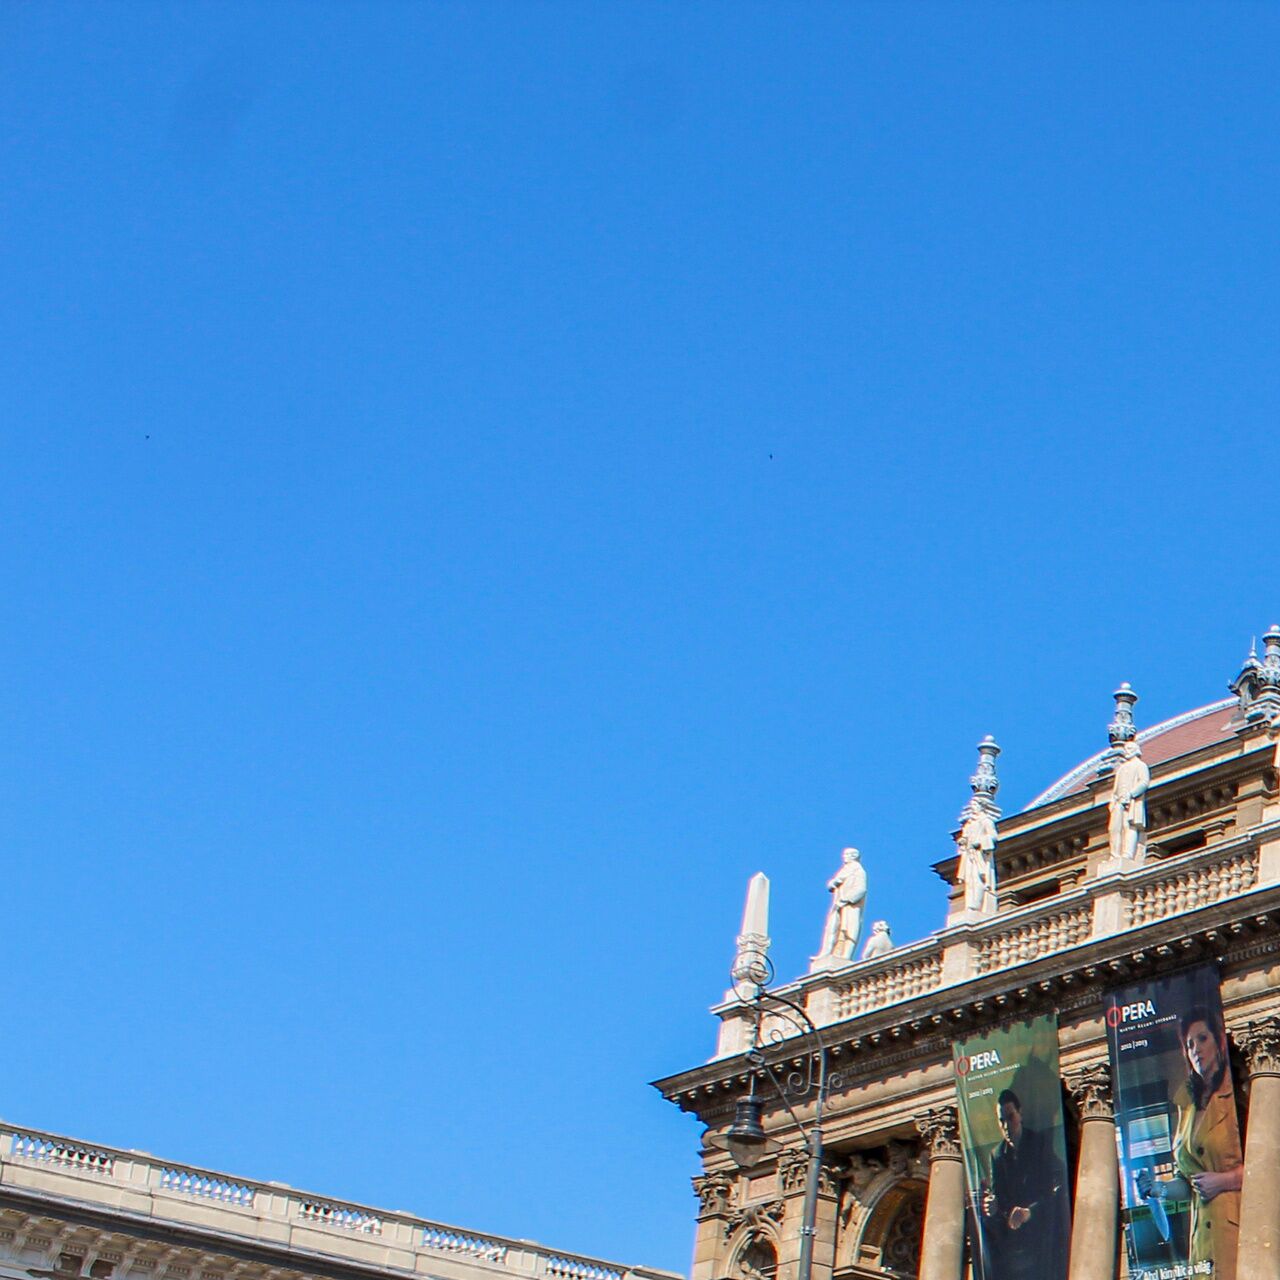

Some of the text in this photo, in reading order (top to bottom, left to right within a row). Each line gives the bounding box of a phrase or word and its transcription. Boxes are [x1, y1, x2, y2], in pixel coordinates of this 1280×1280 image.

[1106, 1000, 1156, 1028] OPERA
[957, 1049, 1001, 1077] OPERA
[1188, 1265, 1193, 1276] a
